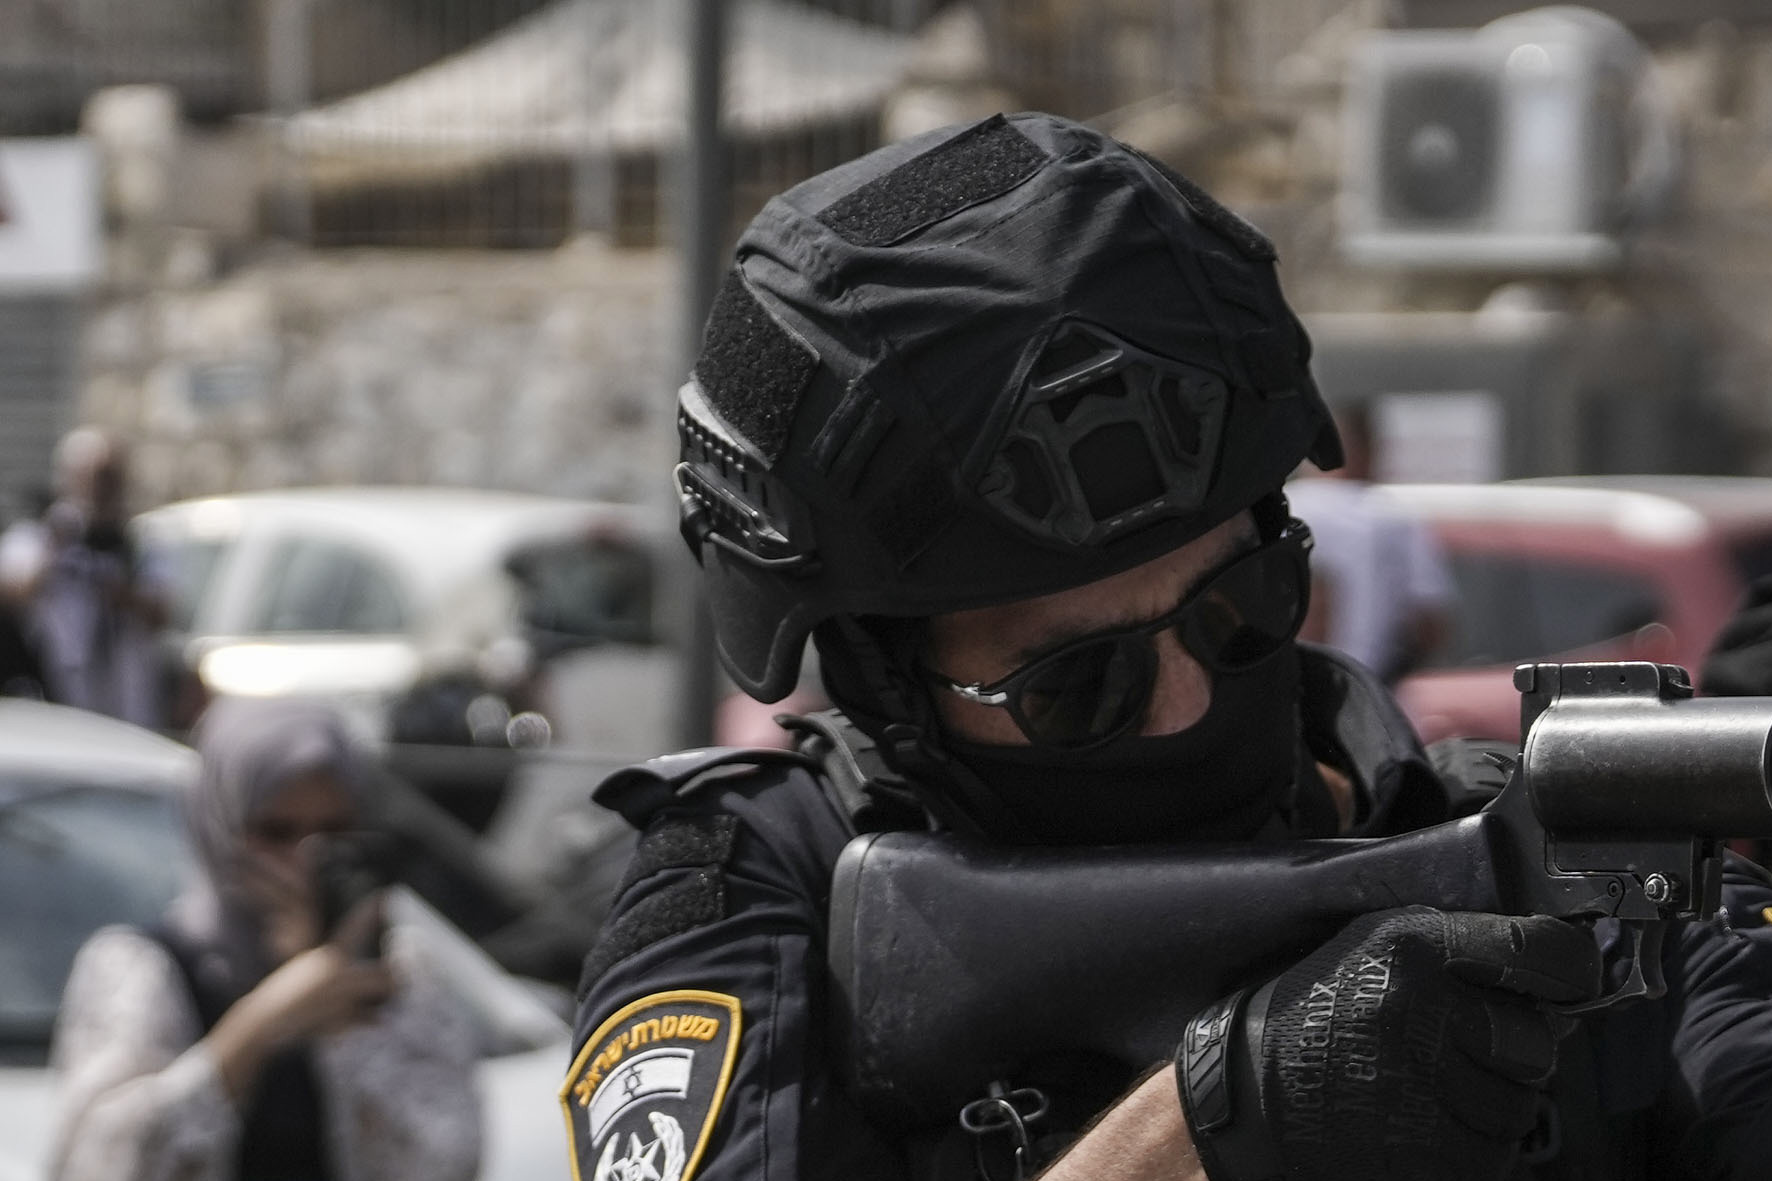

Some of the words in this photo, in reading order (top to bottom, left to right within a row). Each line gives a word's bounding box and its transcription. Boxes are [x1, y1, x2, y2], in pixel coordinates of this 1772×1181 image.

[575, 1031, 630, 1107] ישראל
[627, 1014, 719, 1051] משטרת
[1283, 981, 1341, 1141] Mechanix
[1333, 953, 1393, 1112] Mechanix
